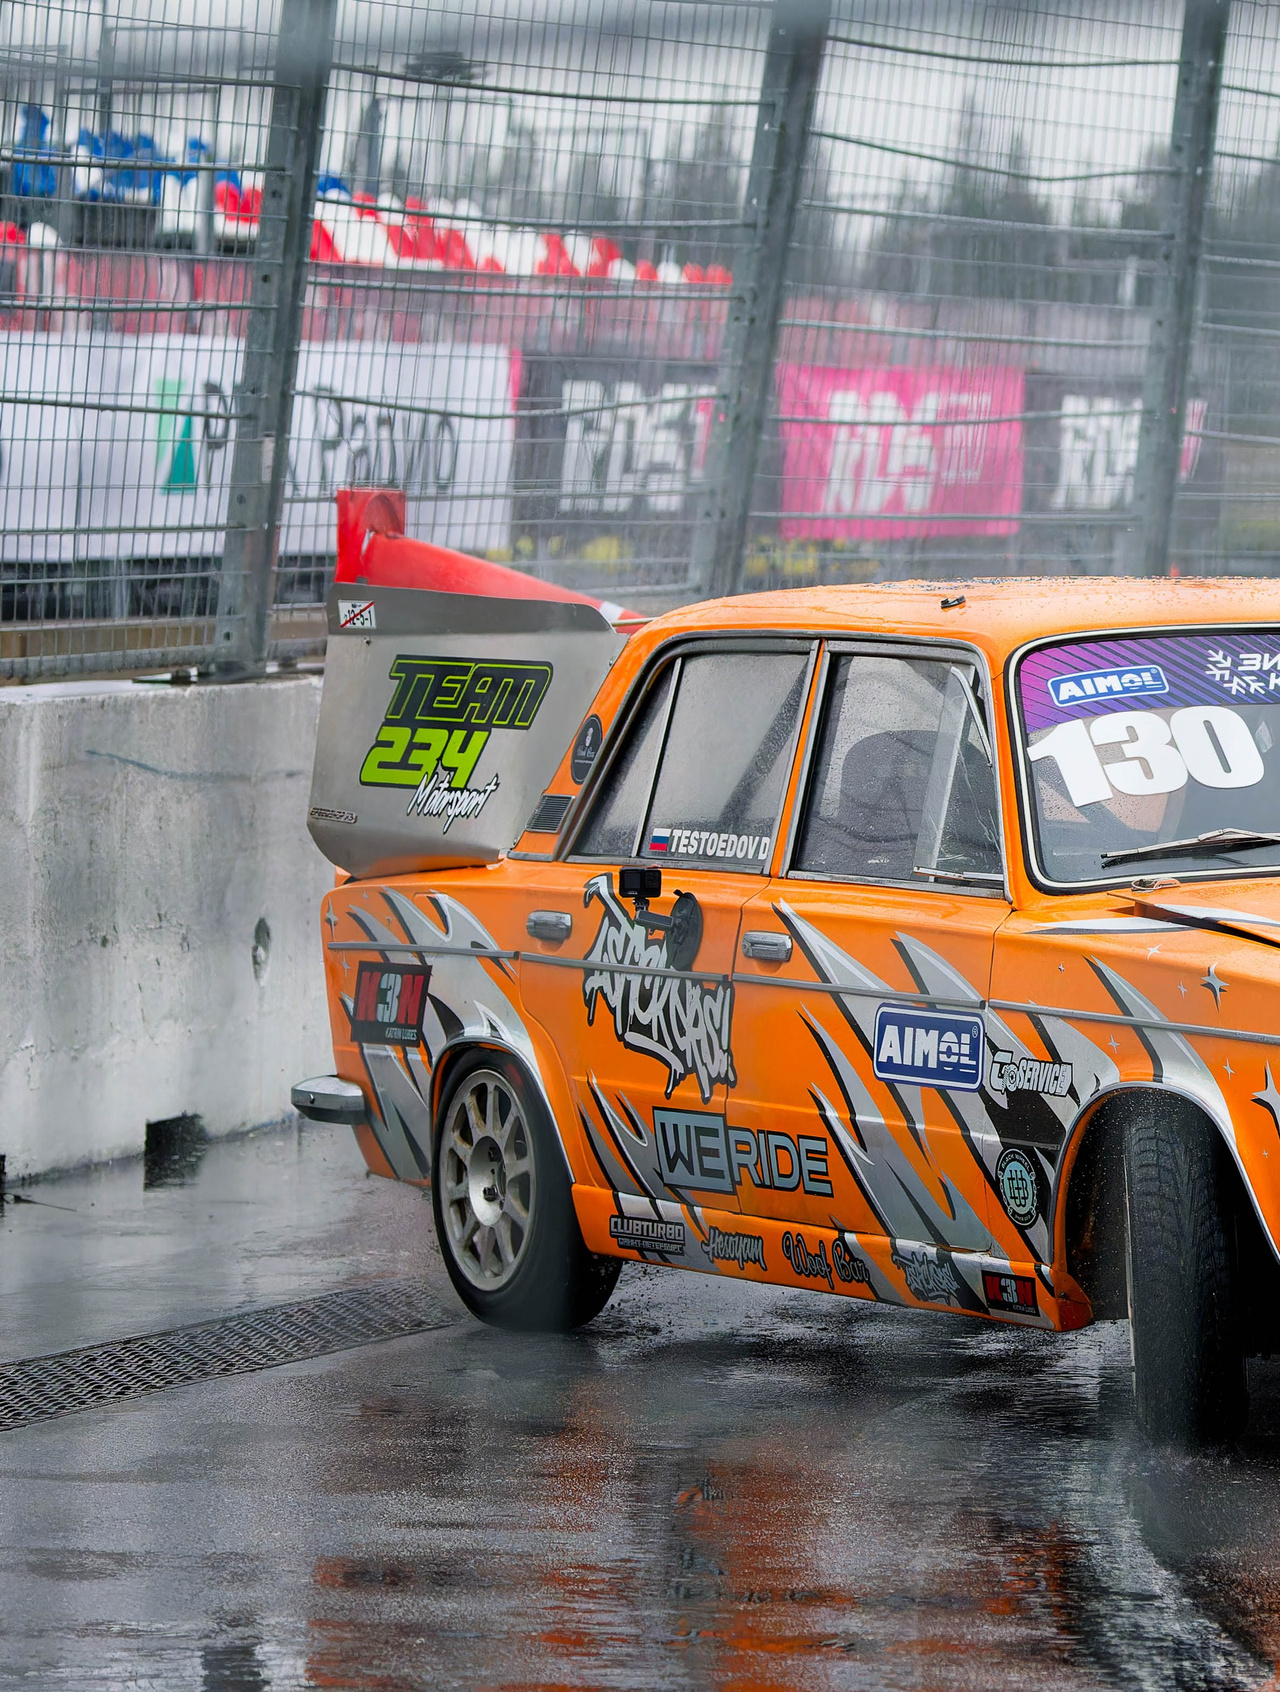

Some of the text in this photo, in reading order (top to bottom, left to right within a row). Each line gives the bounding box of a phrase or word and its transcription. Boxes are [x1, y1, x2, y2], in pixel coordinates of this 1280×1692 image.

[386, 659, 551, 726] TEAM
[360, 726, 490, 788] 234
[1026, 705, 1264, 807] 130
[407, 772, 499, 834] Motorsport
[671, 829, 770, 860] TESTOEDOV D
[782, 1232, 835, 1290] Woof
[832, 1238, 870, 1284] Bar
